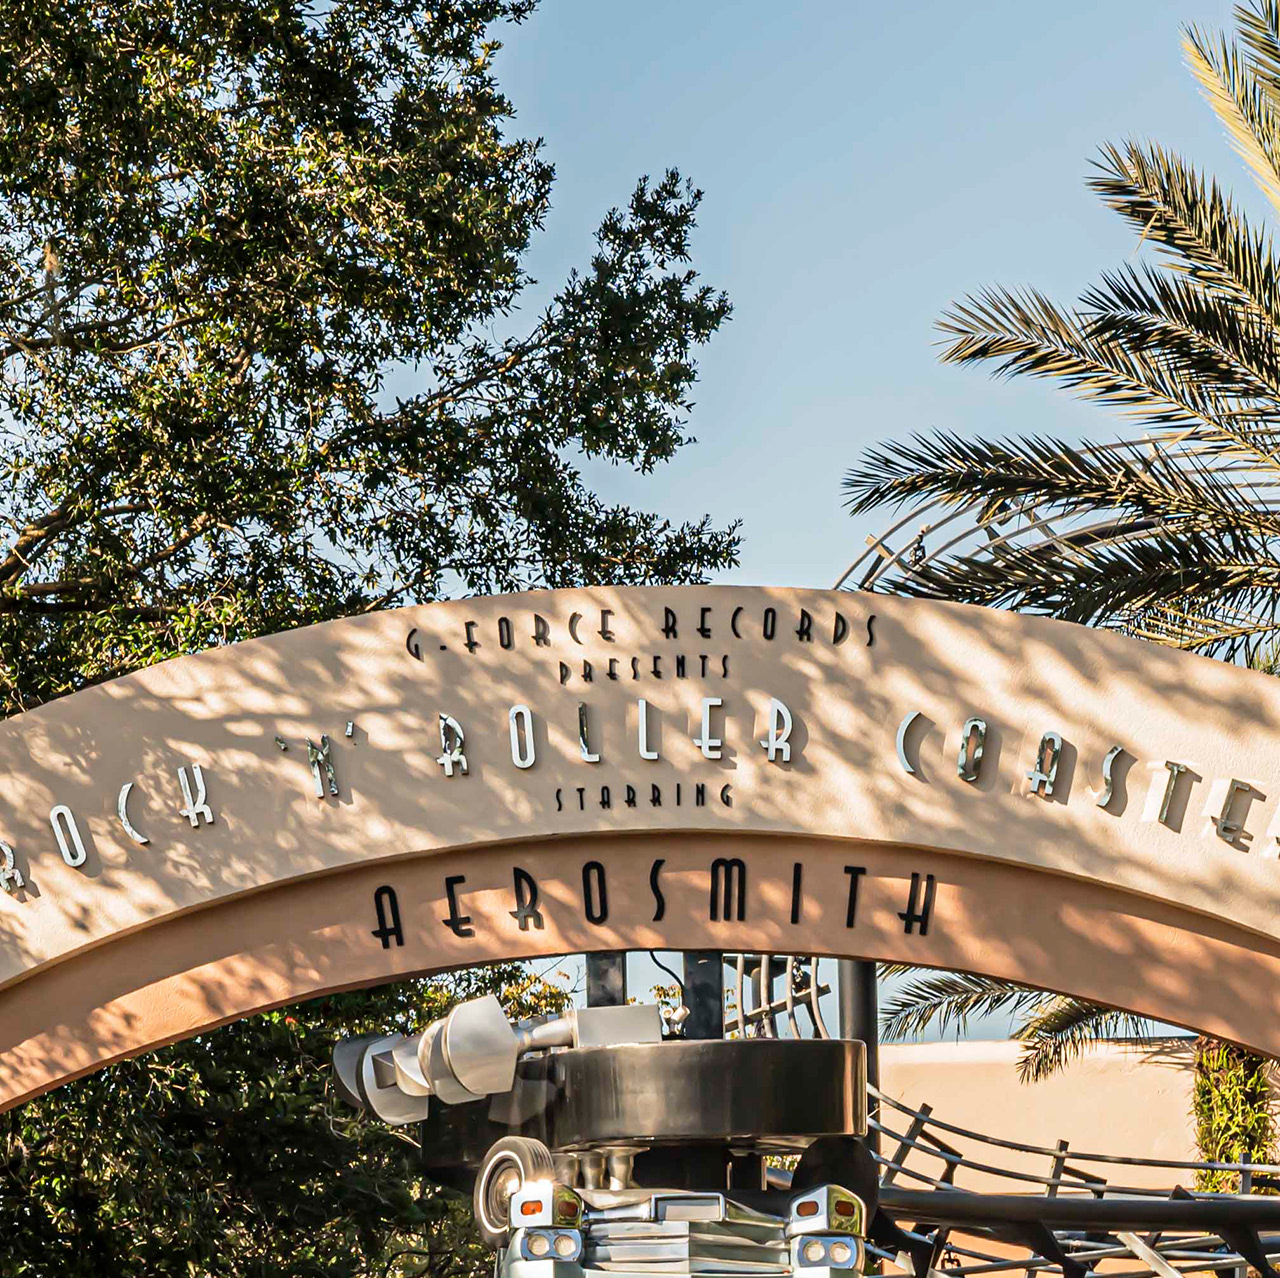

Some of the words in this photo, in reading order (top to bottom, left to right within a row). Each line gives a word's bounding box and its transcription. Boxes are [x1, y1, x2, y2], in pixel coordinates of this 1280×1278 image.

[406, 608, 615, 661] G-FORCE
[661, 606, 878, 647] RECORDS
[558, 654, 731, 685] PRESENTS
[436, 697, 794, 778] ROLLER
[555, 783, 734, 812] STARRING
[371, 857, 937, 950] AEROSMITH
